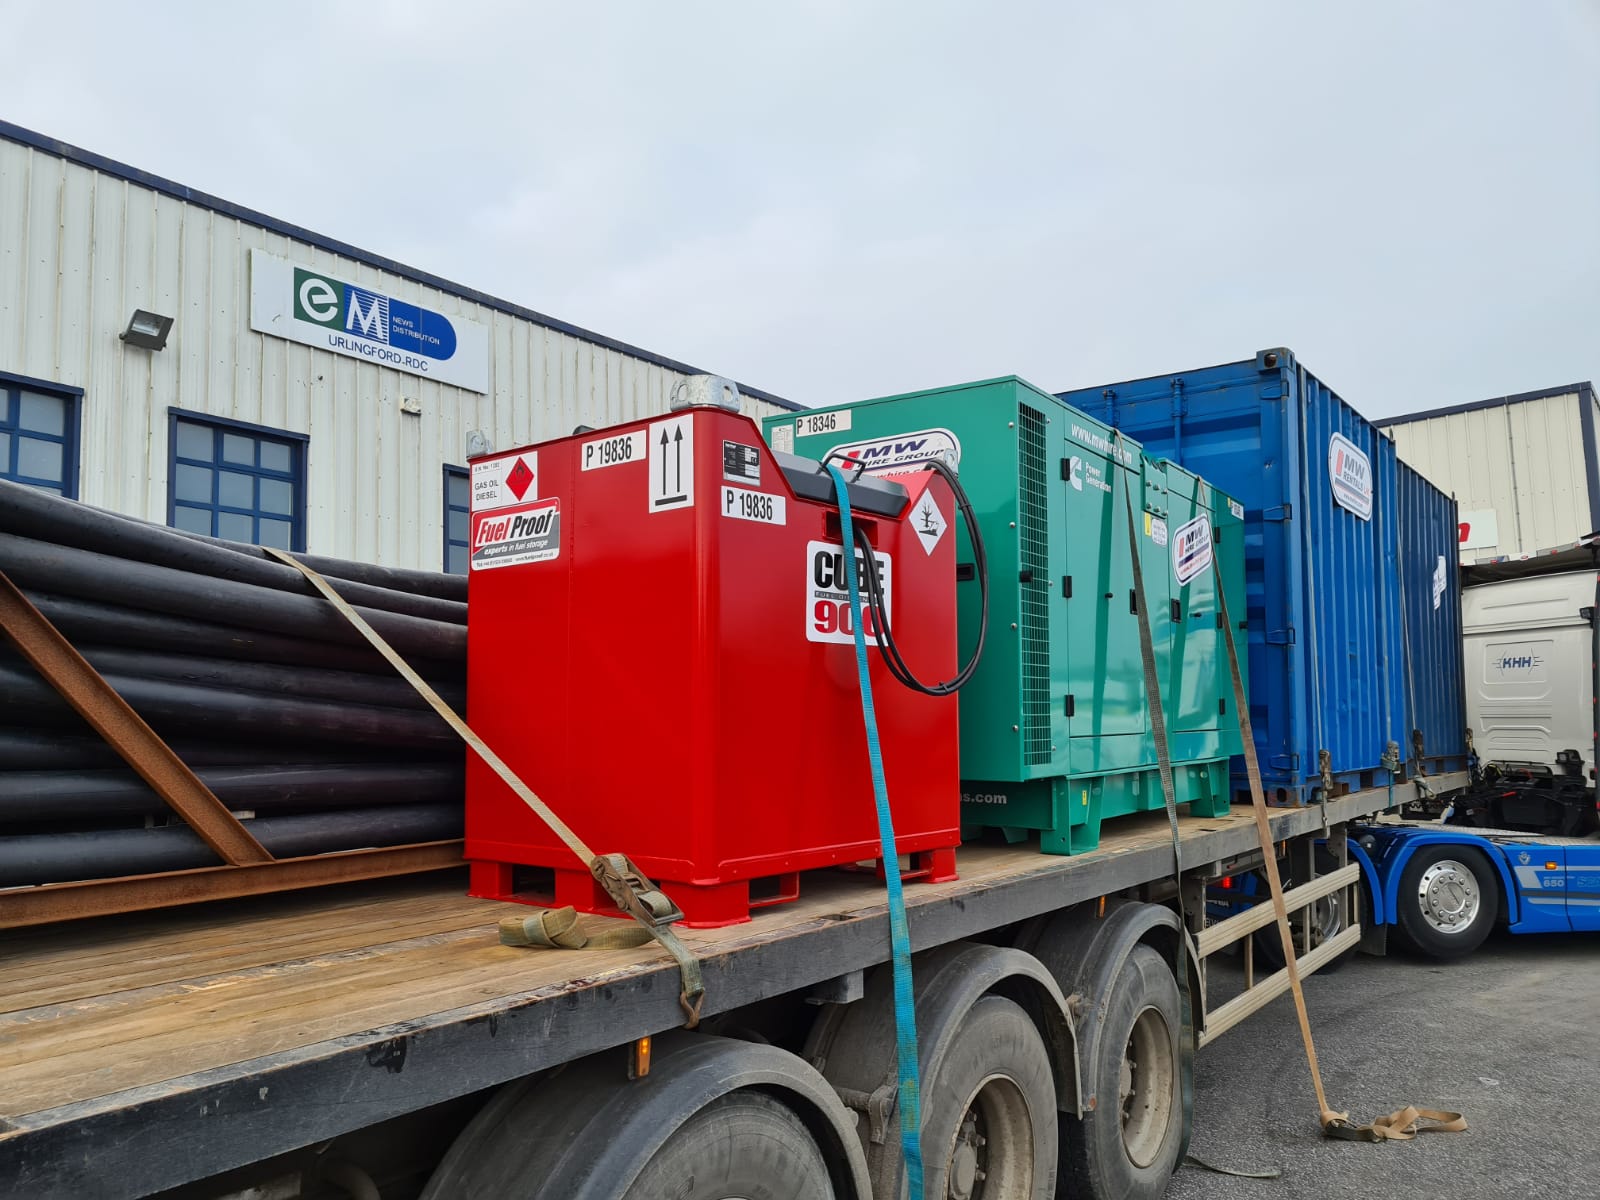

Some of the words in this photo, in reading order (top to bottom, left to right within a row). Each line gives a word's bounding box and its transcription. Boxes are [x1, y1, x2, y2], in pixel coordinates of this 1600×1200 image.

[392, 316, 414, 328] NEWS
[392, 325, 440, 345] DISTRIBUTION
[796, 418, 804, 435] P
[806, 413, 836, 433] 18346
[586, 444, 594, 468] P
[597, 436, 632, 465] 19836
[862, 438, 929, 460] MW
[894, 448, 945, 462] GROUP
[1085, 461, 1101, 477] Power
[1344, 453, 1366, 481] MW
[474, 482, 488, 491] GAS
[488, 480, 499, 488] OIL
[1085, 472, 1112, 494] Generation
[475, 490, 498, 501] DIESEL
[726, 489, 735, 514] P
[739, 492, 773, 521] 19836
[478, 517, 512, 545] Fuel
[509, 509, 554, 539] Proof
[1185, 525, 1204, 547] MW
[484, 545, 508, 556] experts
[508, 543, 515, 551] in
[514, 541, 526, 551] fuel
[526, 538, 549, 550] storage
[1185, 543, 1195, 553] HIRE
[815, 591, 836, 599] FUEL
[814, 600, 884, 637] 900
[1502, 656, 1532, 669] KHH
